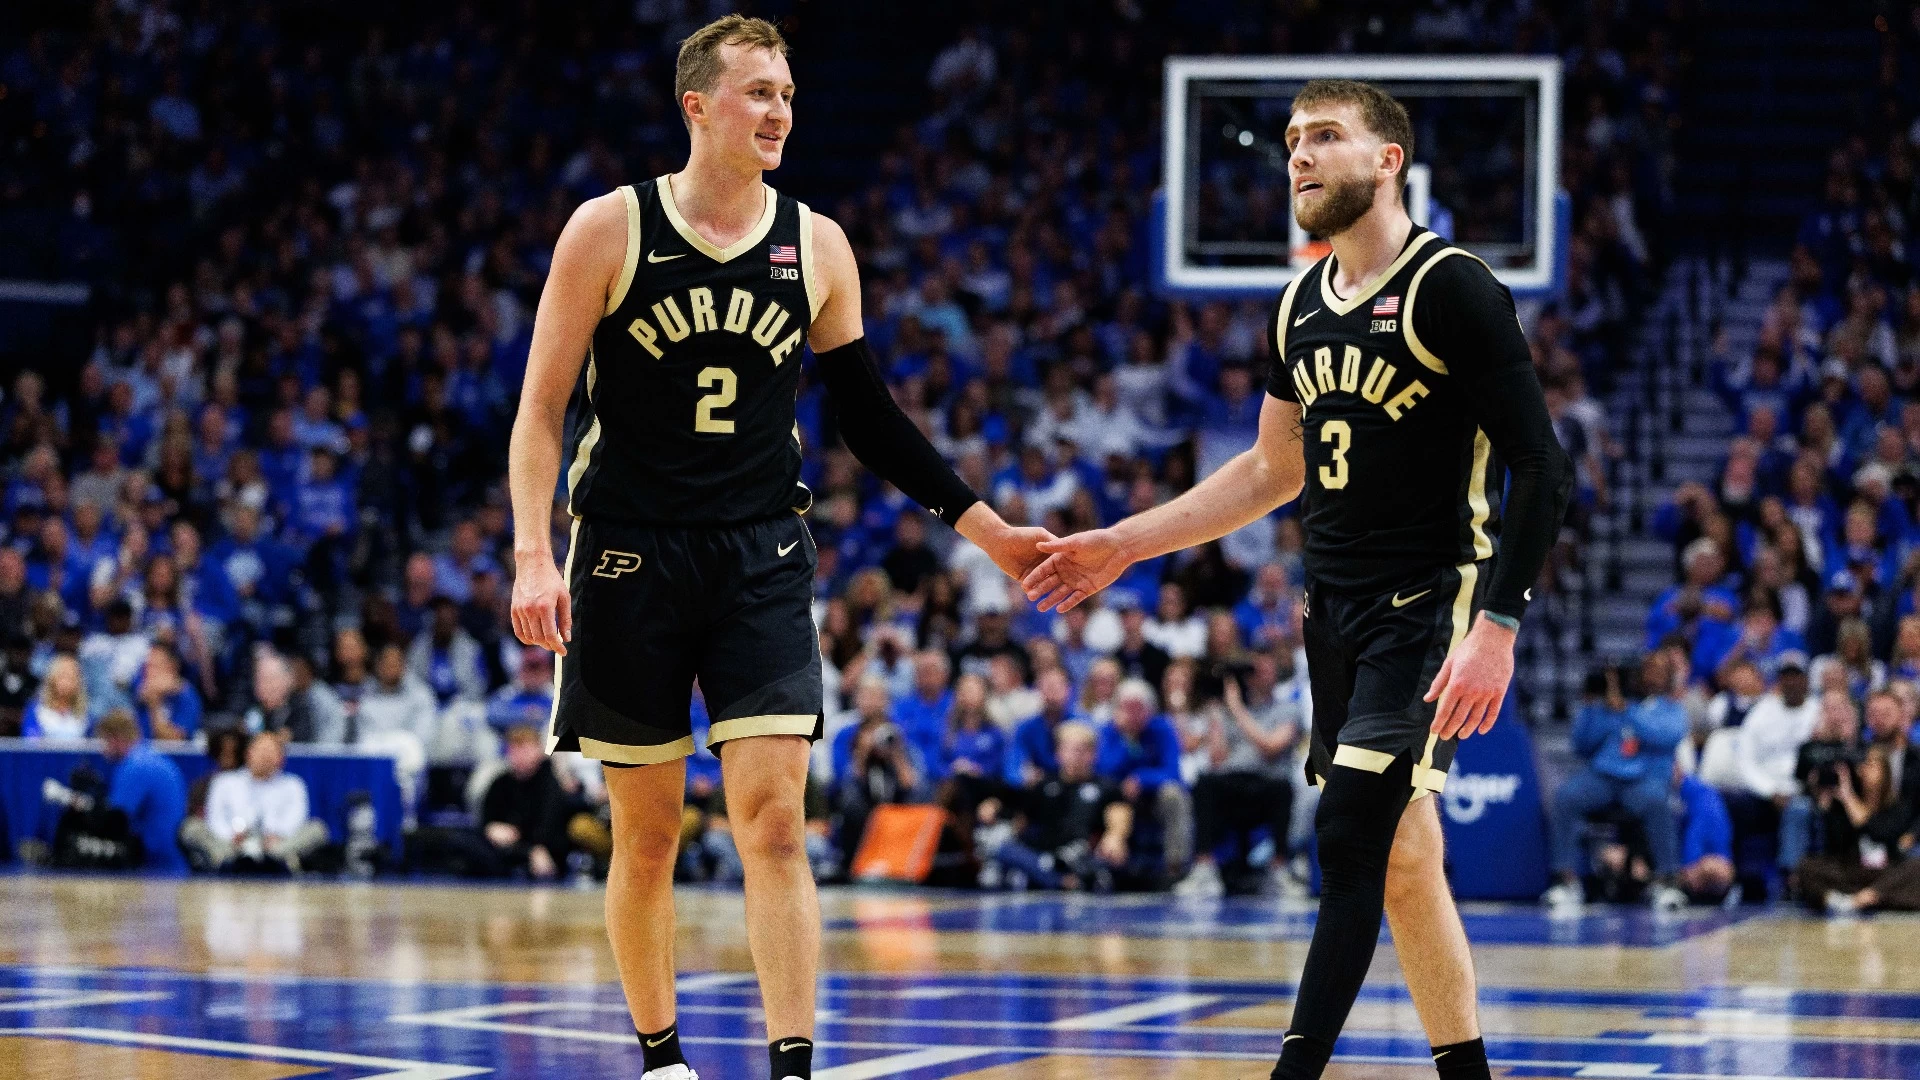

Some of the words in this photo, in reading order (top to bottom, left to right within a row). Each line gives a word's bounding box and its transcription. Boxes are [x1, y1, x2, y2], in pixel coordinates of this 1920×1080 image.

[627, 286, 802, 368] PURDUE
[694, 366, 738, 434] 2
[1292, 344, 1431, 422] URDUE
[1318, 420, 1352, 490] 3
[591, 549, 642, 579] P
